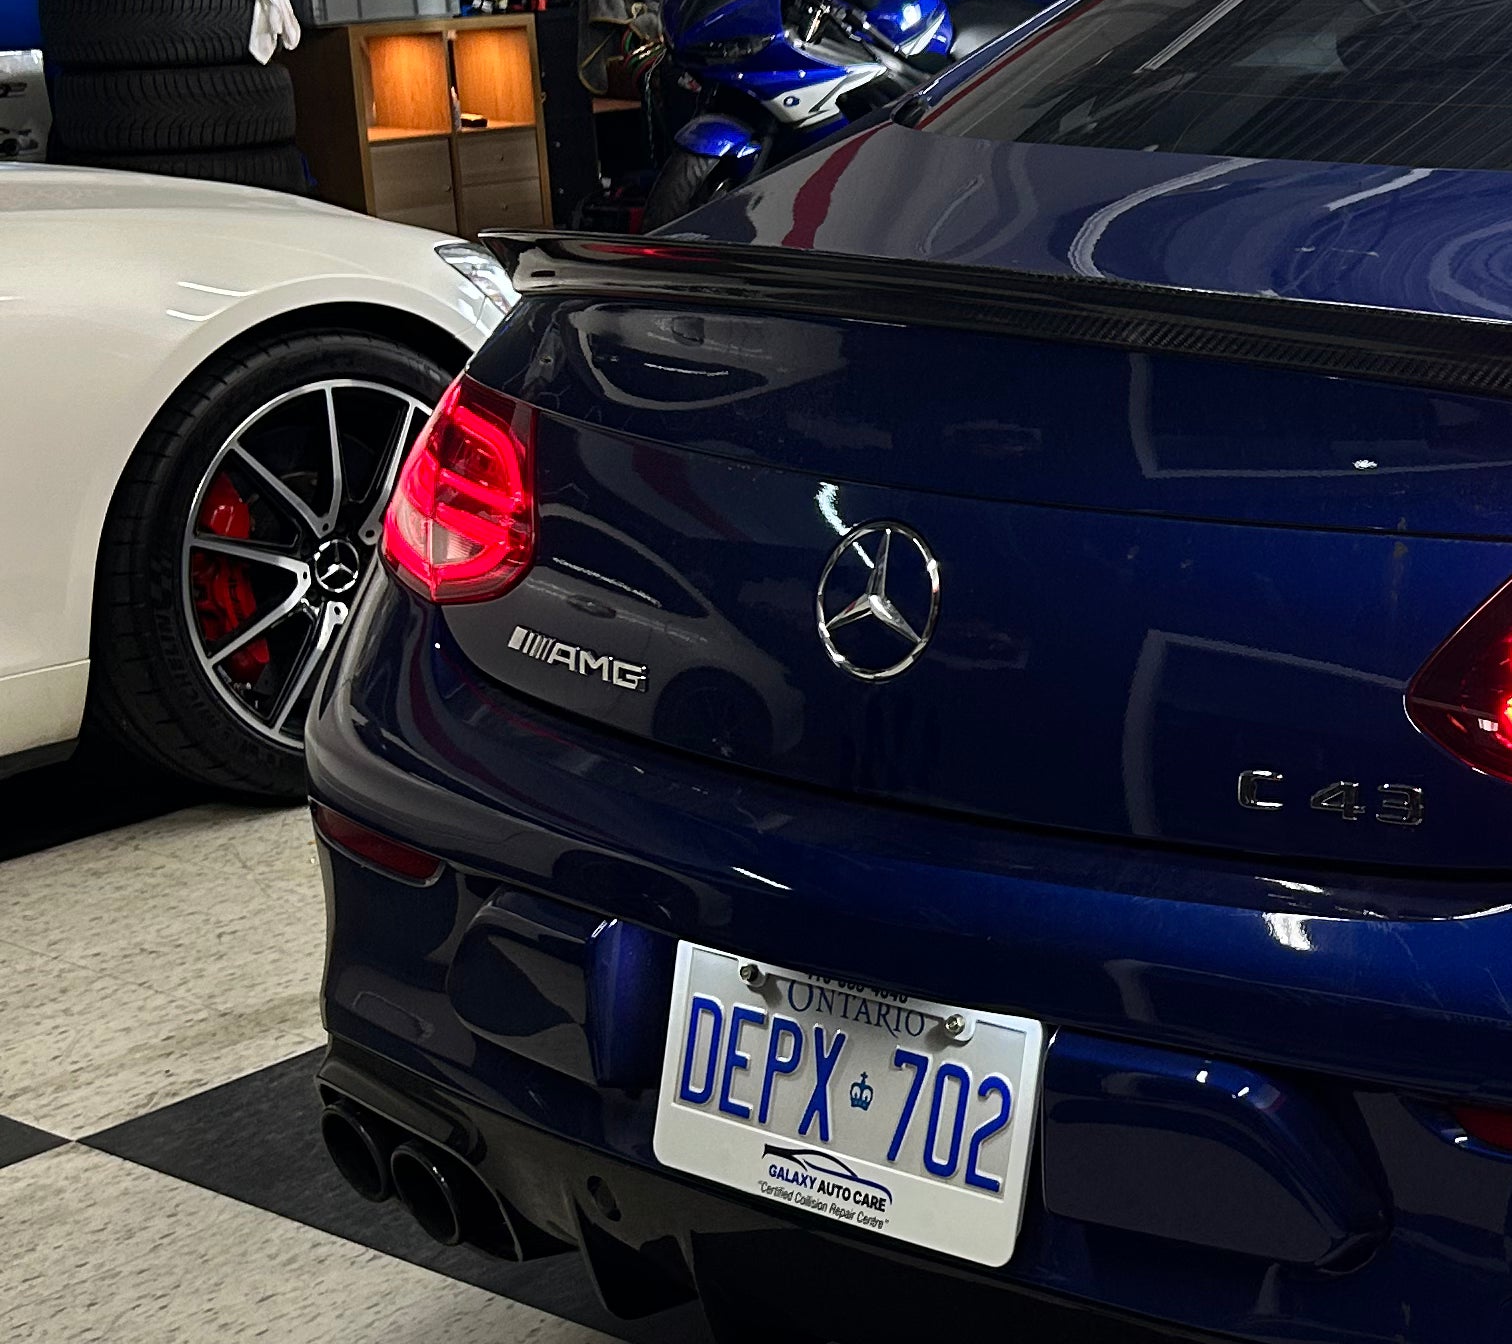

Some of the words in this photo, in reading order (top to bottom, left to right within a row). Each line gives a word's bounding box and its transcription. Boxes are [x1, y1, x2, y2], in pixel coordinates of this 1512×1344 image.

[1237, 769, 1284, 811] C
[1309, 779, 1426, 826] 43
[787, 979, 926, 1039] ONTARIO
[679, 994, 846, 1142] DEPX
[885, 1044, 1014, 1194] 702
[768, 1163, 818, 1190] GALAXY
[816, 1179, 852, 1202] AUTO
[853, 1190, 887, 1213] CARE
[794, 1191, 828, 1213] Collision
[828, 1202, 857, 1220] Repair
